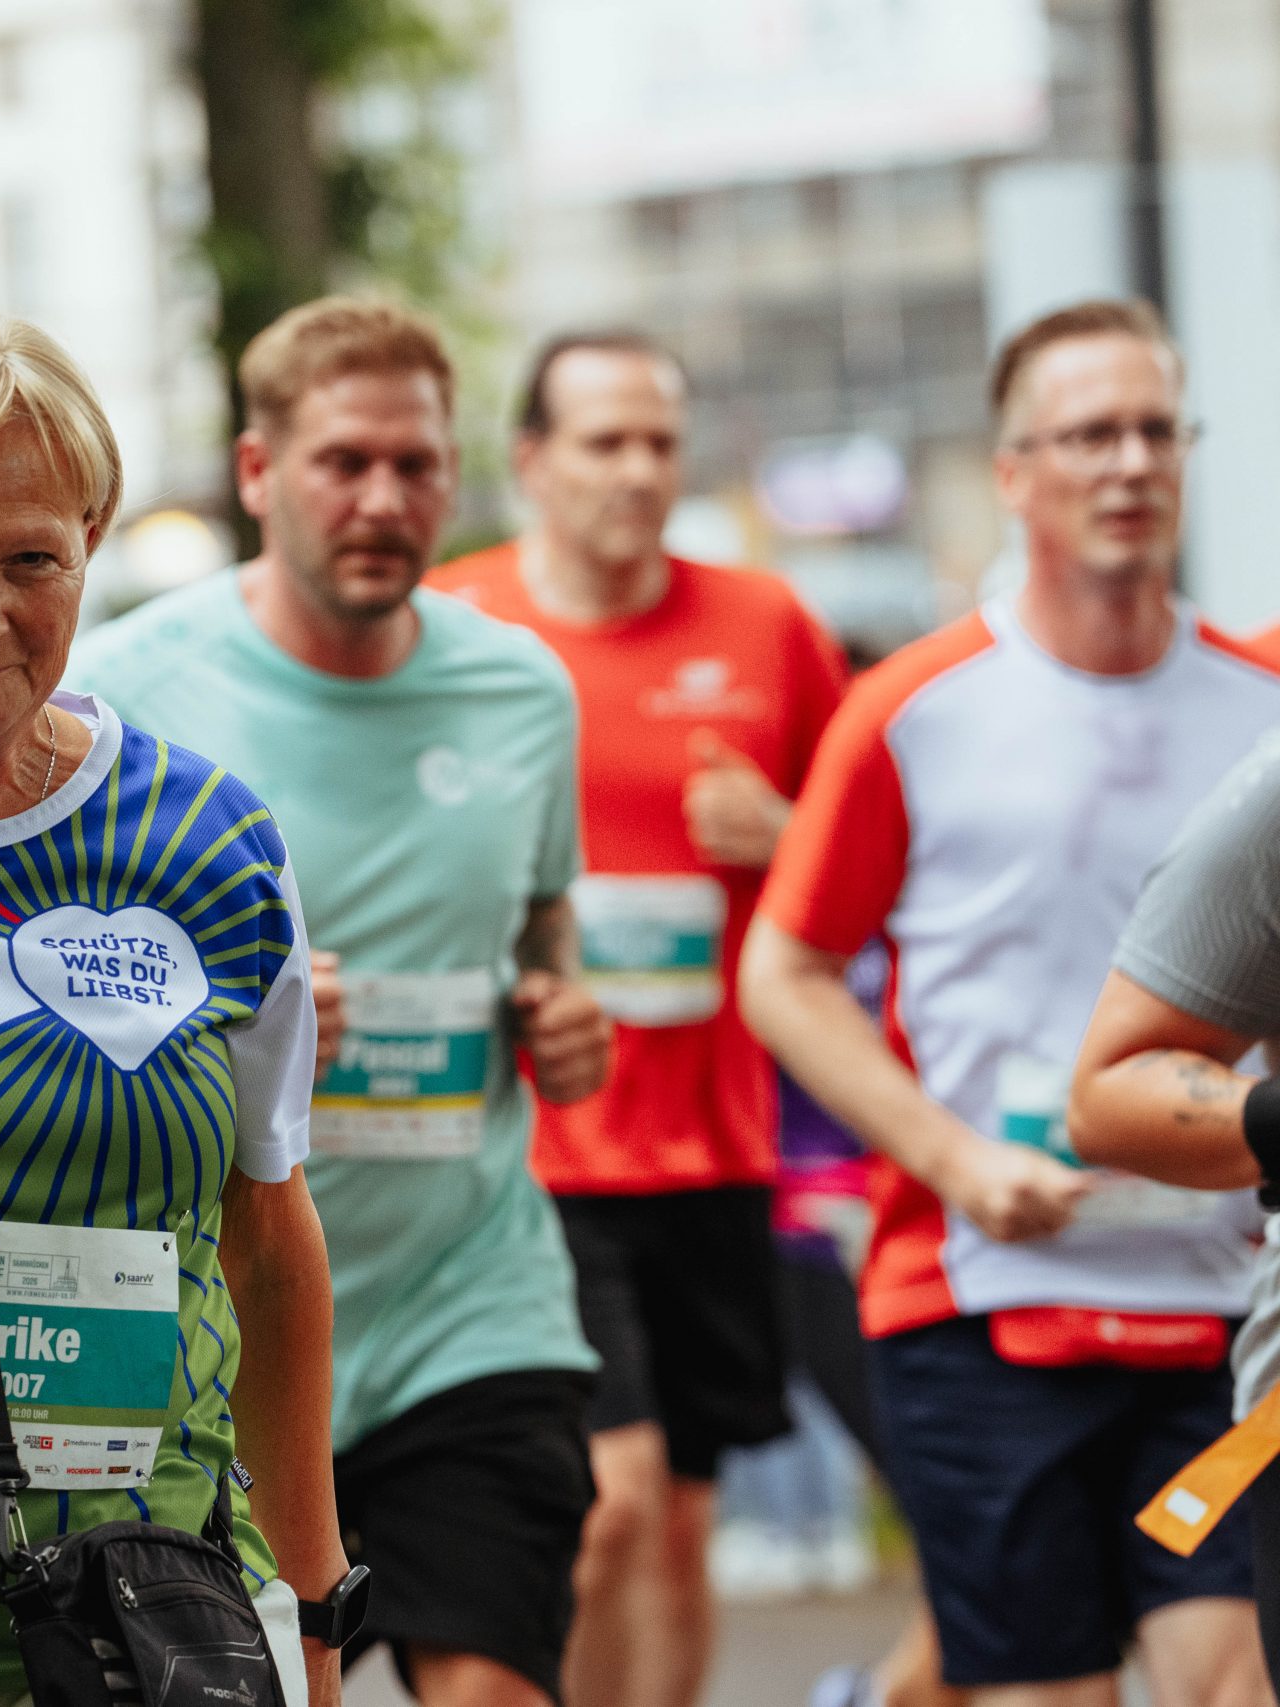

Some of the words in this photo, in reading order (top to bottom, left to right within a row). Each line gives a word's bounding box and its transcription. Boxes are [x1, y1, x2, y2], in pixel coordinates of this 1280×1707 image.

[40, 933, 177, 969] SCHÜTZE,
[59, 952, 120, 978] WAS
[130, 962, 167, 986] DU
[67, 975, 172, 1007] LIEBST.
[1, 1371, 45, 1399] 007
[33, 1408, 49, 1420] UHR
